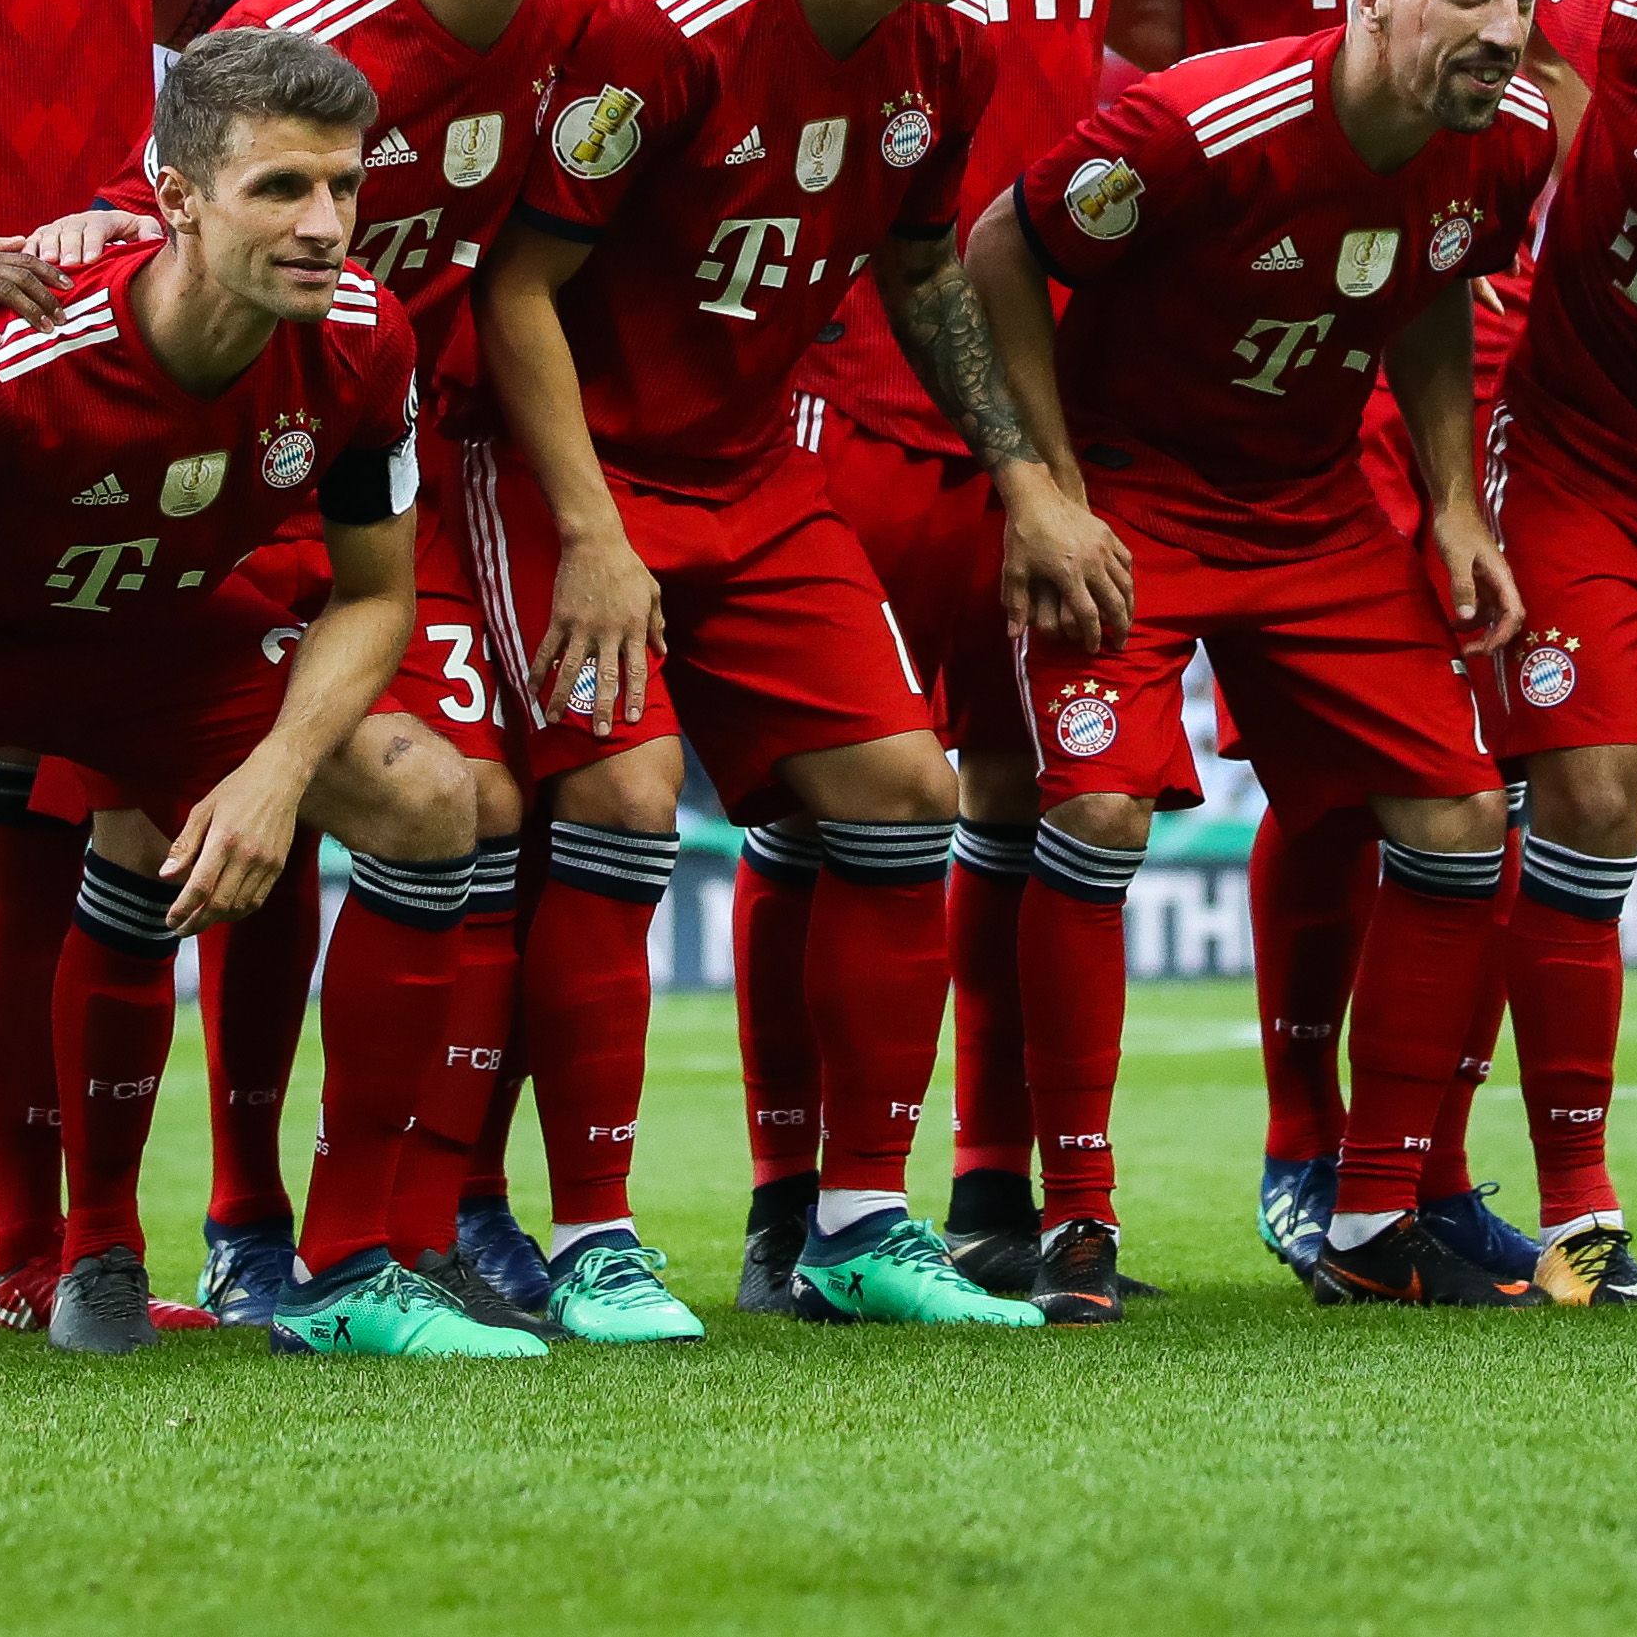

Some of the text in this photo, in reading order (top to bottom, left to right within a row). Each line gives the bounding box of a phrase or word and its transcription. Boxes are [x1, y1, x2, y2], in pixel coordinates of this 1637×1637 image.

[363, 149, 420, 169] adidas
[724, 147, 767, 165] adidas
[1250, 257, 1305, 271] adidas
[71, 491, 130, 507] adidas
[1070, 702, 1111, 721] BAYERN
[1274, 1018, 1332, 1039] FCB
[447, 1045, 502, 1070] FCB
[1460, 1056, 1493, 1075] FC
[88, 1075, 156, 1100] FCB
[26, 1106, 62, 1126] FC
[757, 1109, 805, 1125] FCB
[890, 1102, 923, 1121] FC
[1551, 1107, 1604, 1123] FCB
[1058, 1132, 1108, 1149] FCB
